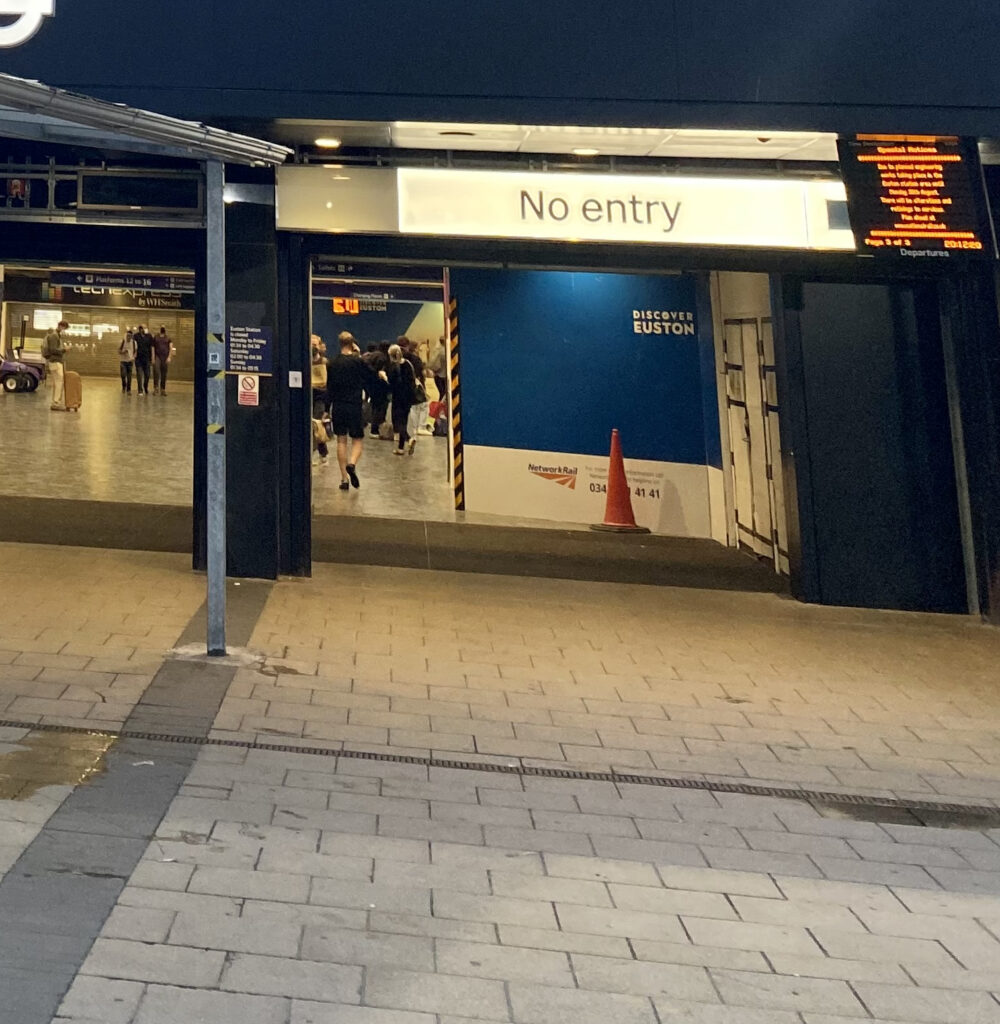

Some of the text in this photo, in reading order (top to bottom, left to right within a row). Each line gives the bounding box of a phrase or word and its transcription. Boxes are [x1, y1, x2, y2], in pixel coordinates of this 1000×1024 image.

[520, 190, 681, 233] No entry
[900, 248, 950, 258] Departures
[632, 310, 693, 321] DISCOVER
[633, 321, 695, 335] EUSTON
[634, 487, 645, 498] 41
[648, 488, 660, 499] 41
